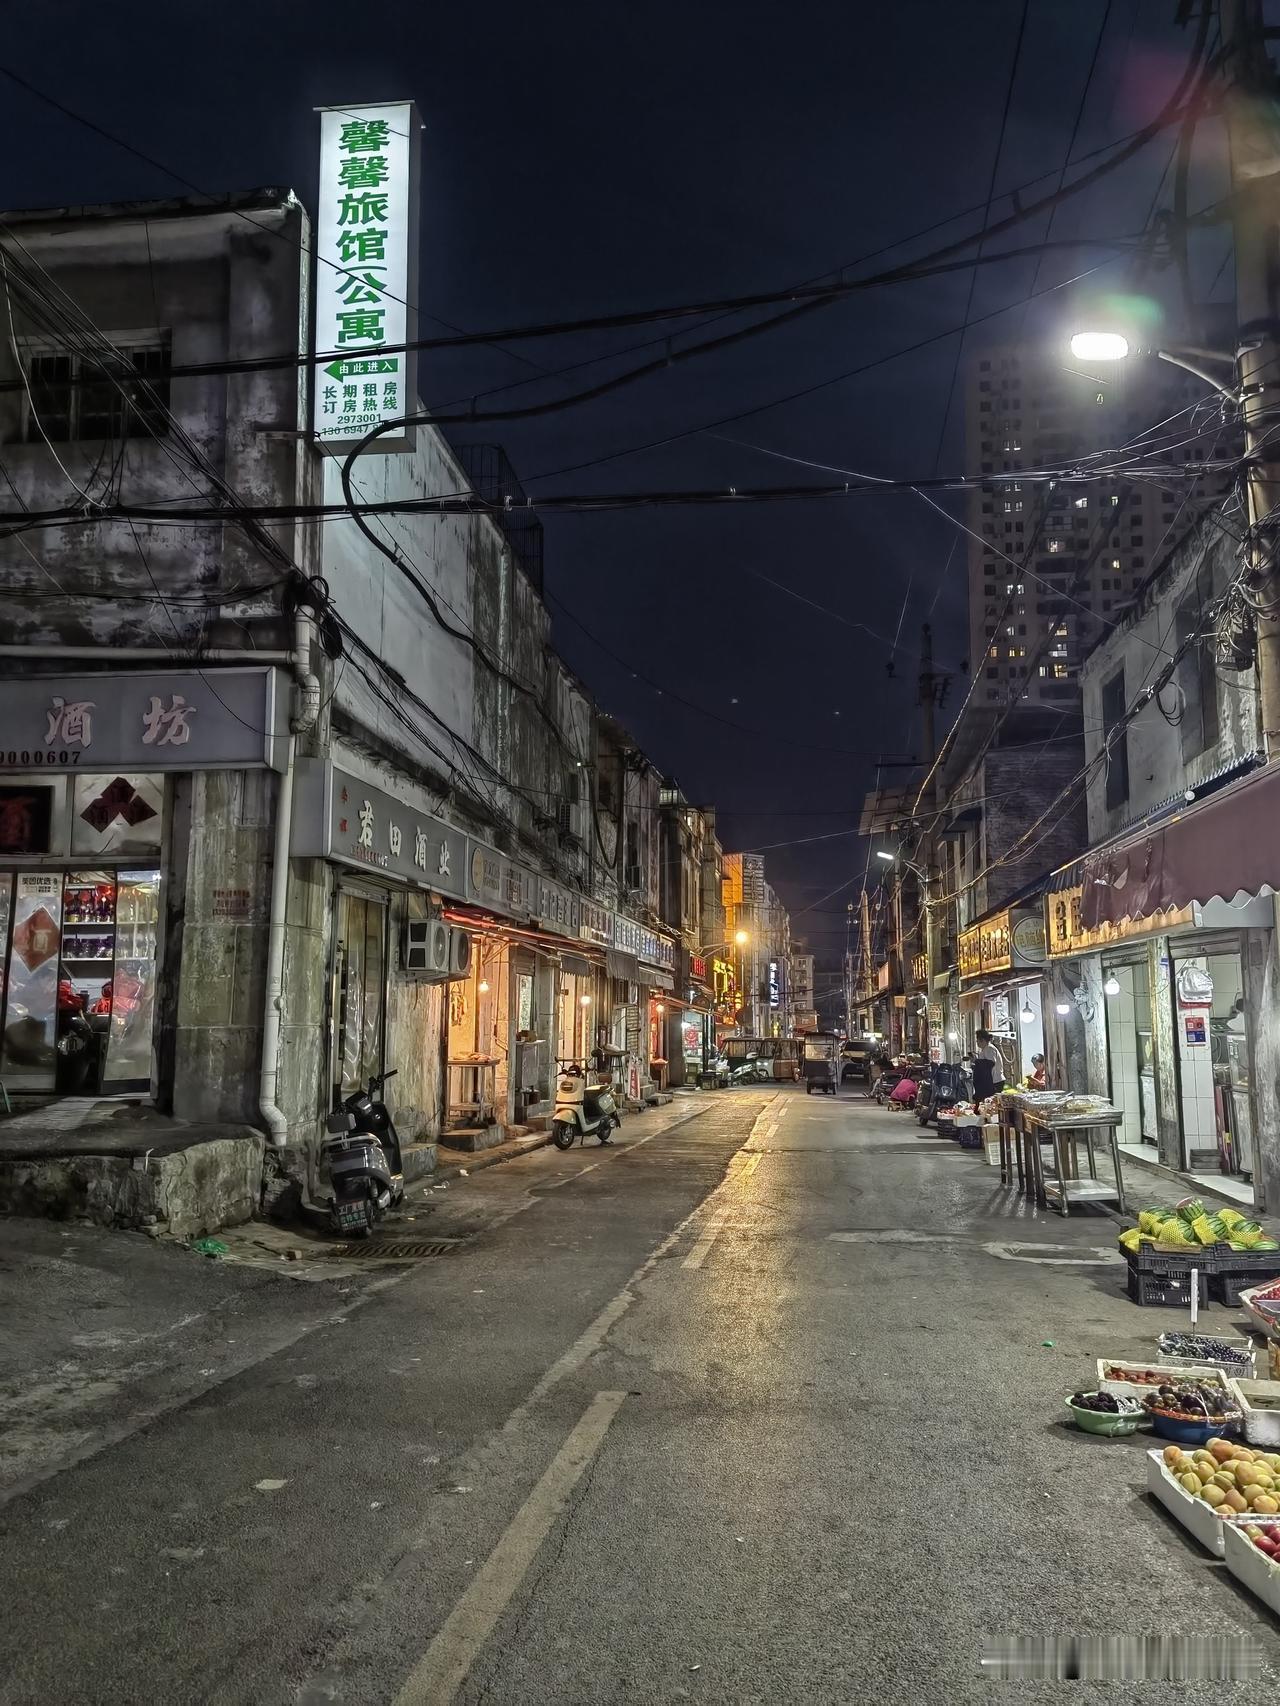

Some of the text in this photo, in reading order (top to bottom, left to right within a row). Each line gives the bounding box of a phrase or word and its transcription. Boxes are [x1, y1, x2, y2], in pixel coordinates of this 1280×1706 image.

[339, 362, 393, 374] 由此进入
[322, 381, 398, 400] 长期租房
[322, 396, 398, 414] 订房热线
[337, 414, 381, 425] 2973001
[44, 694, 197, 748] 酒坊
